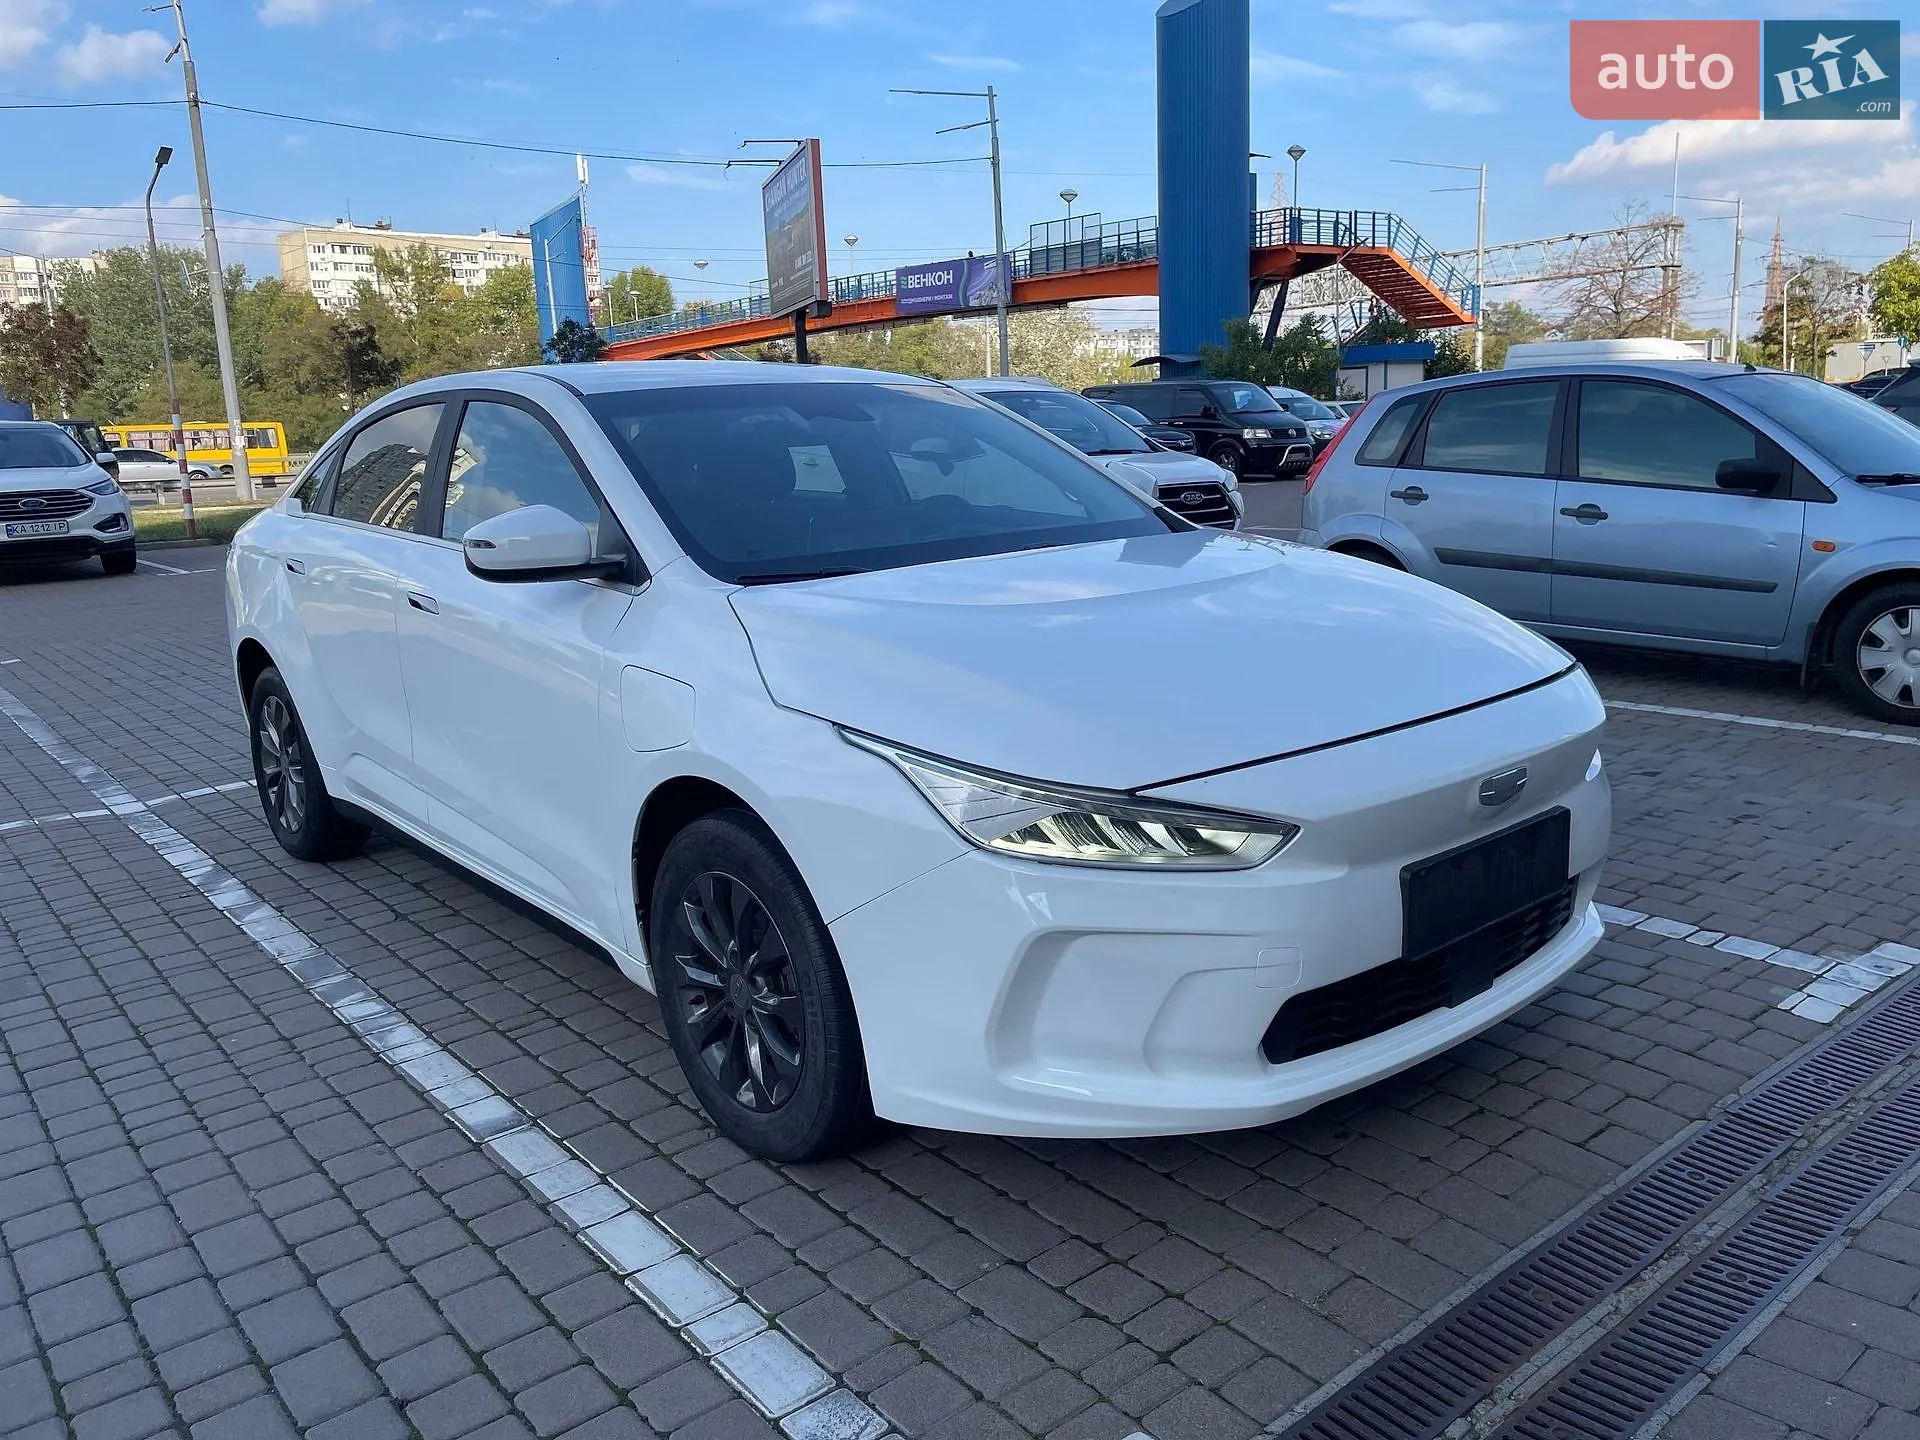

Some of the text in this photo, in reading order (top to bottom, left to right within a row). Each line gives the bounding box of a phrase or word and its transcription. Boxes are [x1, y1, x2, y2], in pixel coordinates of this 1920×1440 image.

[908, 270, 953, 289] ВЕНКОН
[12, 525, 27, 534] KA
[30, 524, 51, 533] 1212
